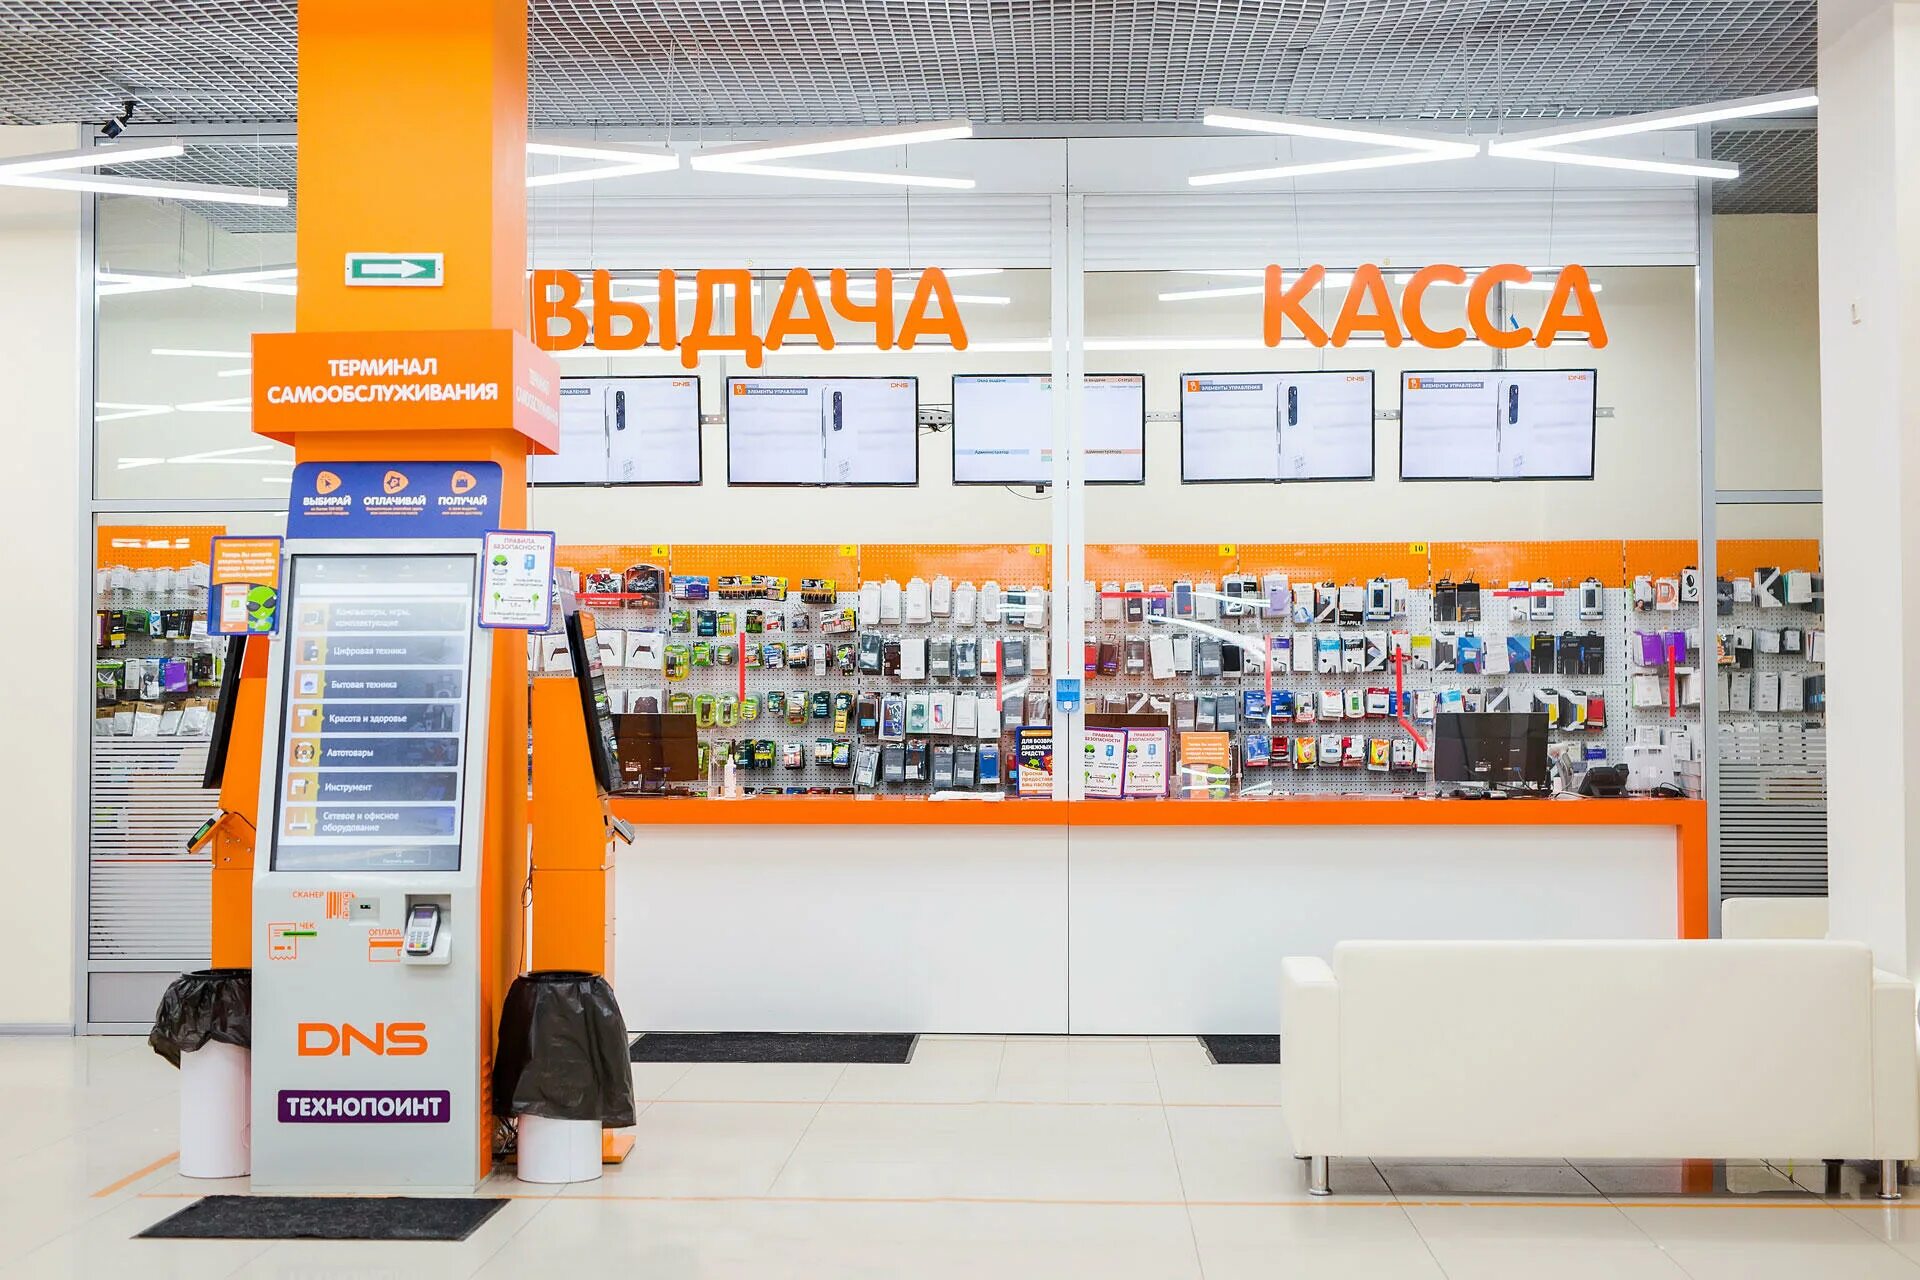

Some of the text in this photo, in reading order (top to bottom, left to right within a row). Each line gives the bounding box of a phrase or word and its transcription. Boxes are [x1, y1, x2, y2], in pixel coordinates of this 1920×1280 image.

[1263, 263, 1608, 349] КАССА
[530, 267, 969, 369] ВЫДАЧА
[328, 358, 437, 377] ТЕРМИНАЛ
[267, 383, 498, 404] САМООБСЛУЖИВАНИЯ
[303, 495, 351, 506] ВЫБИРАЙ
[363, 495, 426, 506] ОПЛАЧИВАЙ
[438, 495, 487, 506] ПОЛУЧАЙ
[333, 647, 407, 656] Цифровая техника
[331, 680, 398, 689] Бытовая техника
[329, 714, 361, 724] Красота
[370, 715, 407, 724] здоровье
[326, 749, 374, 758] Автотовары
[324, 783, 373, 792] Инструмент
[323, 811, 355, 820] Сетевое
[364, 812, 400, 822] офисное
[322, 823, 380, 832] оборудование
[297, 1022, 428, 1056] DNS
[286, 1097, 442, 1117] ТЕХНОПОИНТ
